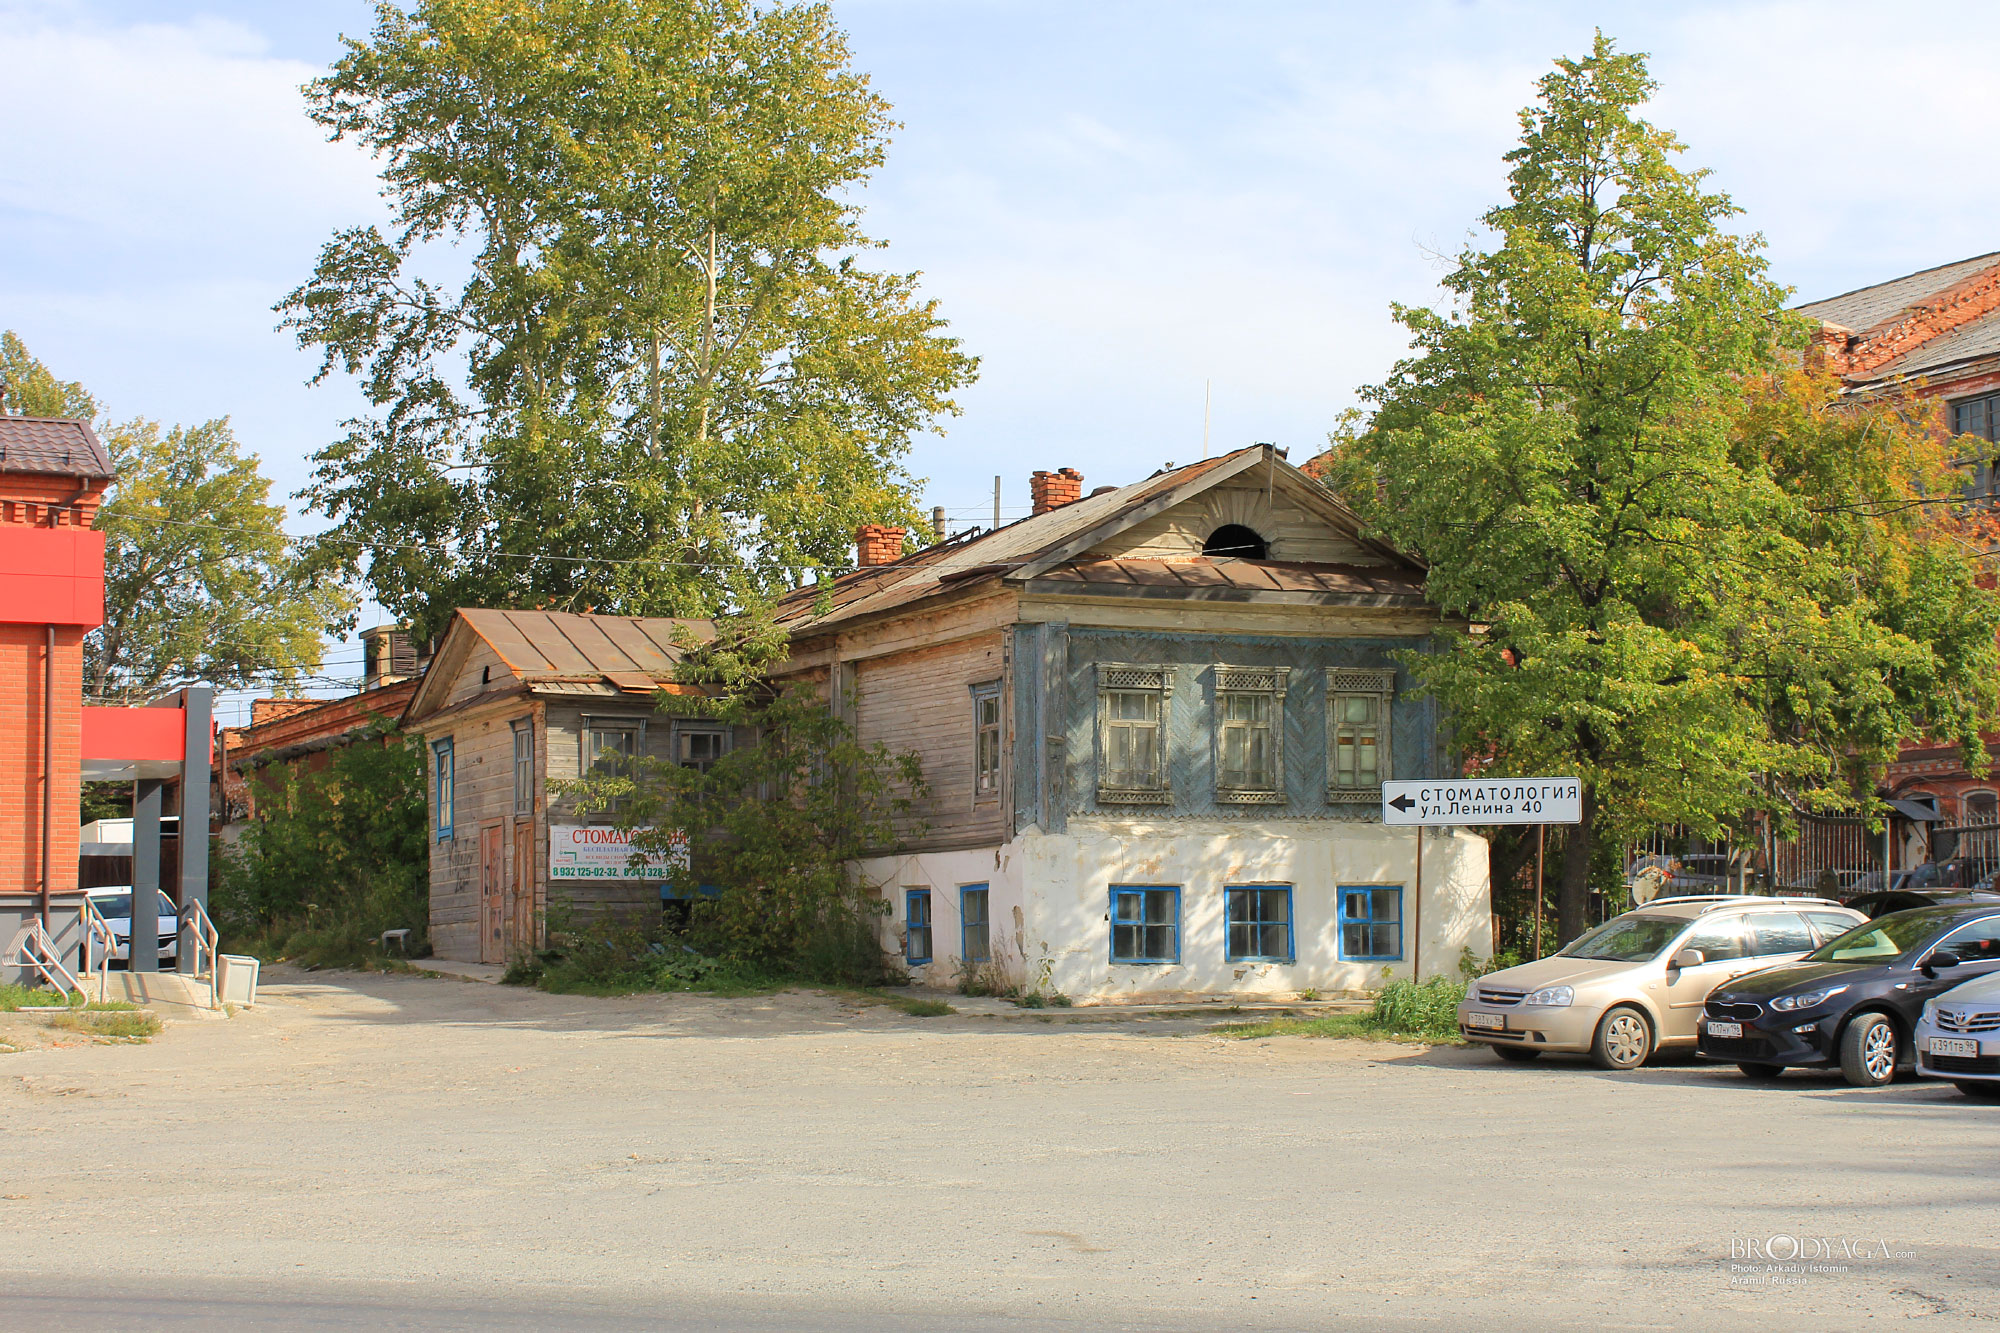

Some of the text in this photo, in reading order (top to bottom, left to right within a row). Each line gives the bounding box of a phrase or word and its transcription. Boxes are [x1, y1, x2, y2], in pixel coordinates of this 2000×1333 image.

[1420, 786, 1577, 802] СТОМАТОЛОГИЯ
[1521, 800, 1542, 814] 40
[552, 867, 559, 877] 8
[559, 867, 576, 877] 932
[623, 867, 629, 877] 8
